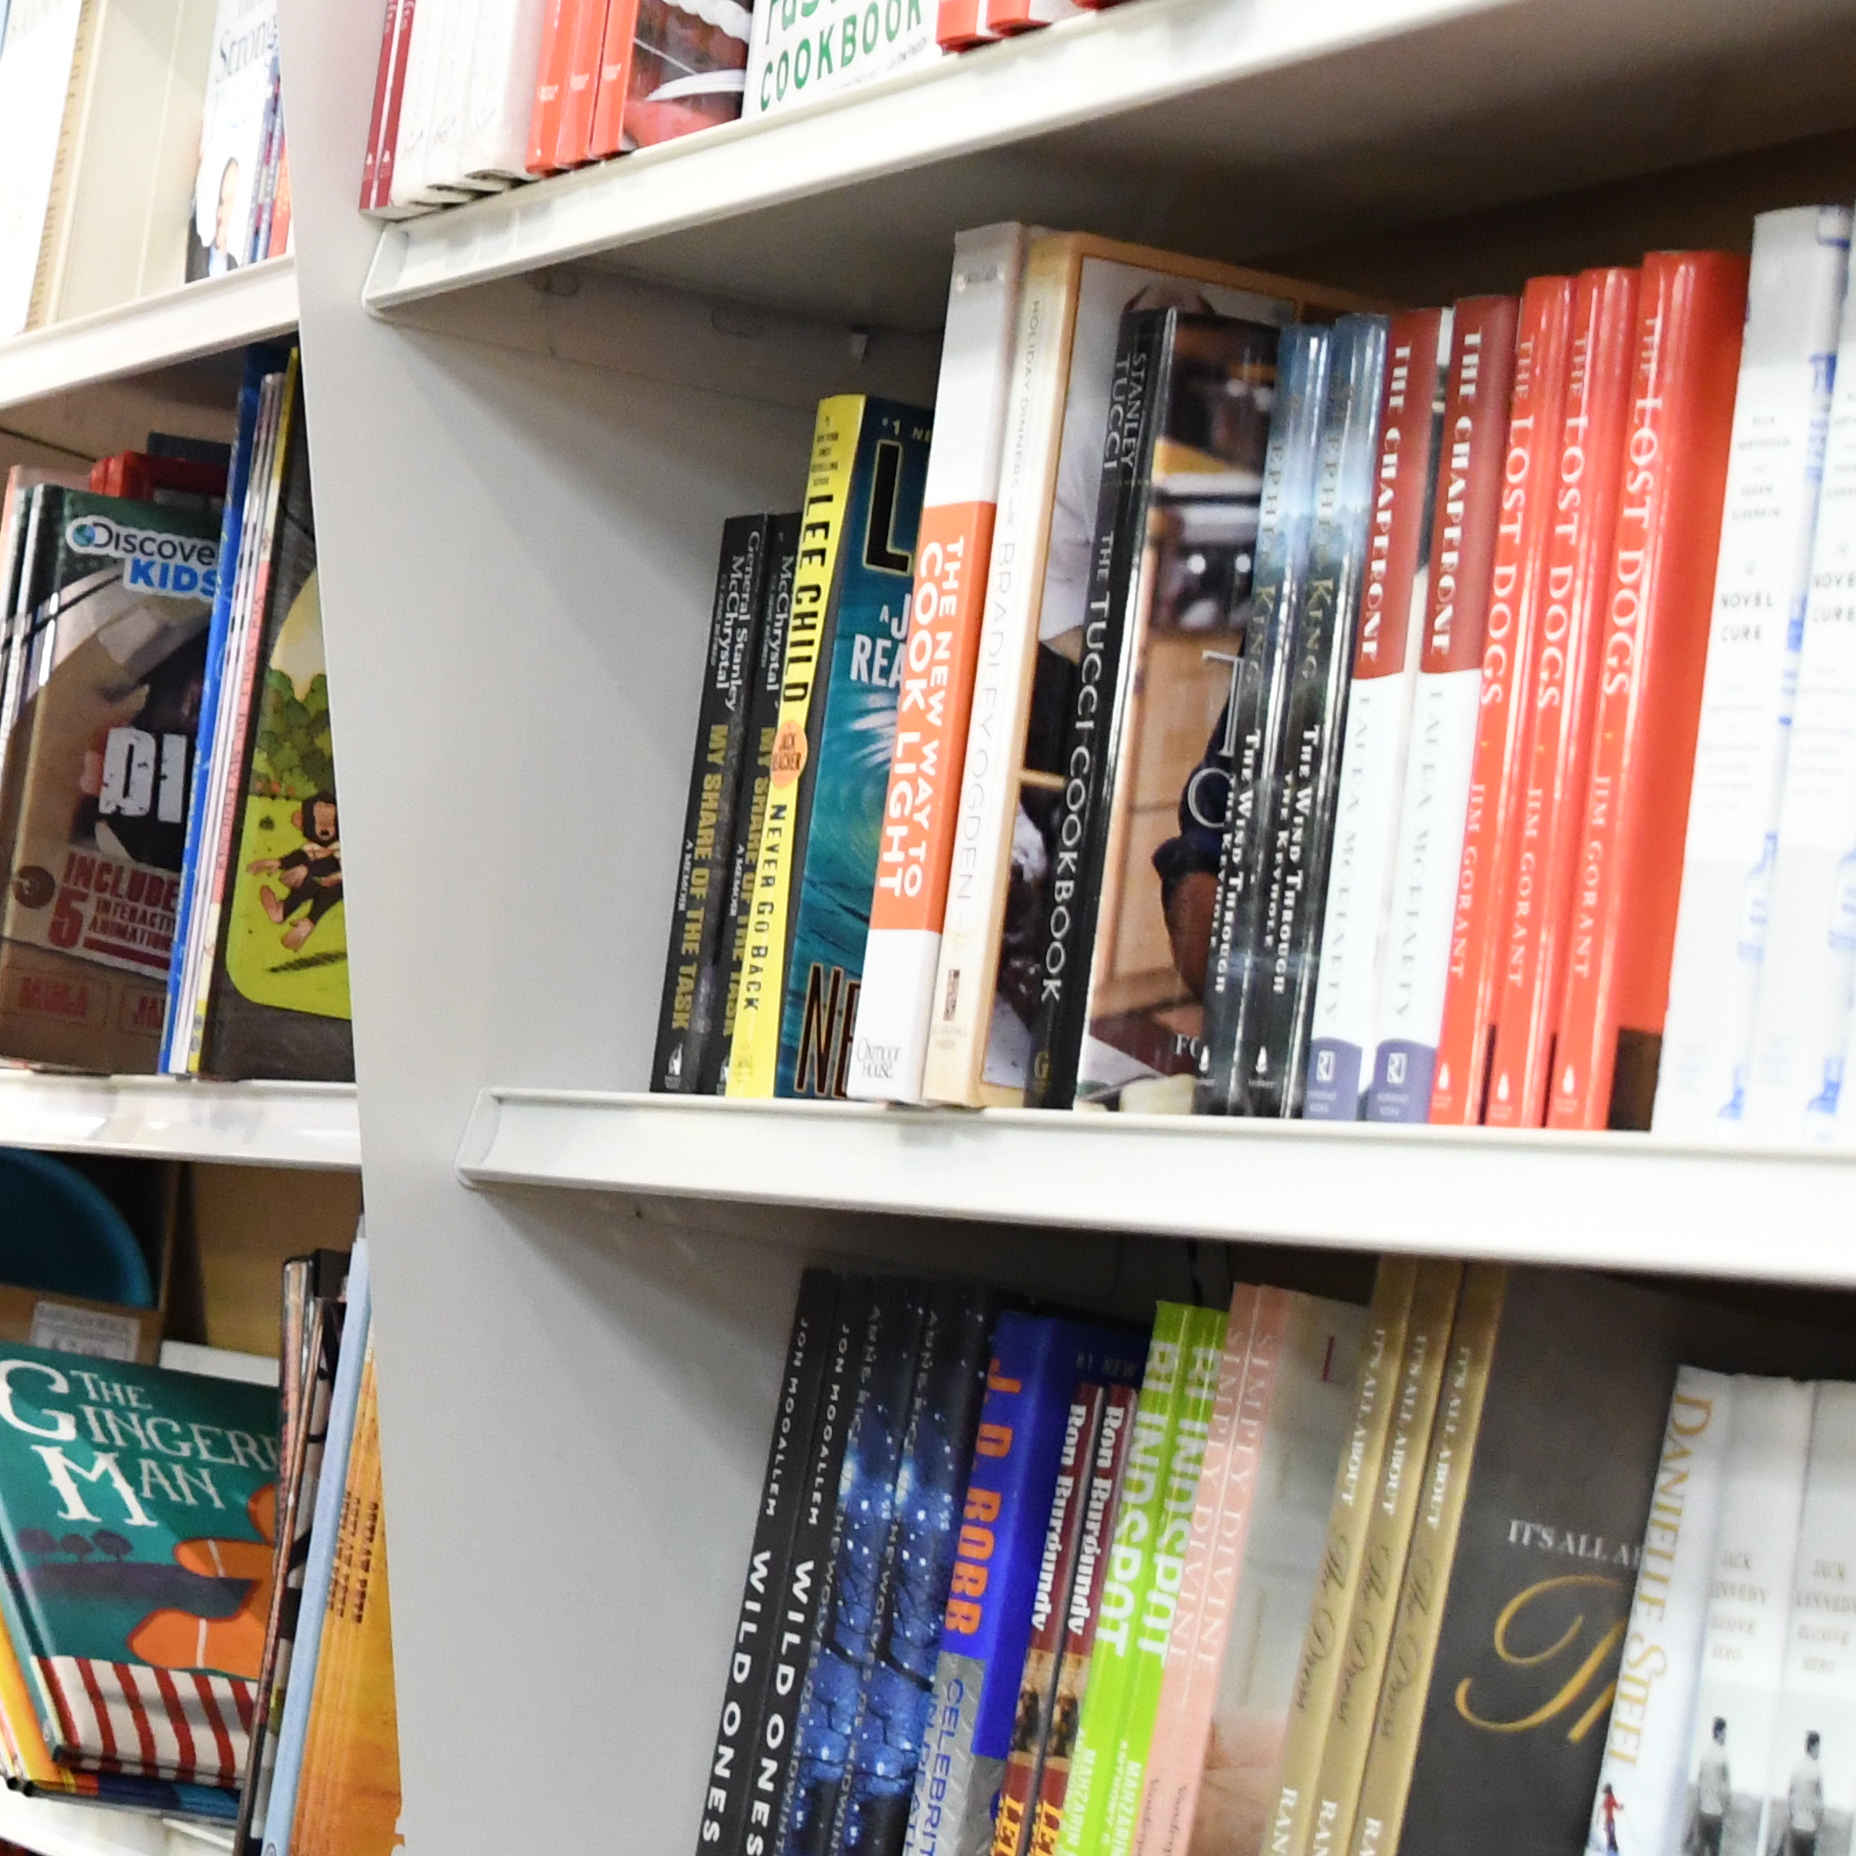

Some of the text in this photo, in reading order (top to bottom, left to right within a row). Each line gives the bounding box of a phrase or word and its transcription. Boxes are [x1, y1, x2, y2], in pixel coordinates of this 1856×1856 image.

[1103, 351, 1146, 471] STANLEY TUCCI
[1430, 329, 1482, 656] THE CHAPERONE
[128, 557, 219, 597] KIDS
[801, 494, 833, 570] LEE
[1360, 344, 1413, 663] THE CHAPERONE
[1479, 413, 1534, 706] LOST DOGS
[1536, 413, 1589, 710] LOST DOGS
[1602, 393, 1663, 697] LOST DOGS
[715, 554, 745, 691] McChrystal
[725, 630, 749, 713] Stanley
[783, 582, 822, 702] CHILD
[1721, 593, 1774, 609] NOVEL
[1721, 626, 1763, 642] CURE
[697, 724, 728, 863] MY SHARE
[878, 542, 943, 898] COOK LIGHT
[902, 536, 964, 898] THE NEW WAY TO
[1041, 531, 1113, 1003] THE TUCCI COOKBOOK
[743, 804, 787, 1011] NEVER GO BACK
[956, 748, 990, 902] OGDEN
[1449, 782, 1487, 979] JIM GORANT
[1508, 786, 1543, 988] JIM GORANT
[1573, 773, 1613, 978] JIM GORANT
[48, 885, 84, 947] 5
[70, 1370, 152, 1410] THE
[764, 1316, 809, 1516] JON MOOALLEM
[808, 1324, 850, 1525] JON MOOALLEM
[1341, 1428, 1366, 1507] ABOUT
[1383, 1433, 1408, 1515] ABOUT
[31, 1445, 226, 1527] MAN
[944, 1488, 1003, 1636] ROBB
[1032, 1403, 1087, 1633] Ron Burgundy
[1068, 1405, 1125, 1635] Ron Burgundy
[1140, 1344, 1225, 1667] BLINDSPOT
[1427, 1445, 1452, 1529] ABOUT
[1507, 1519, 1608, 1562] IT'S ALL
[1170, 1505, 1214, 1664] DIVINE
[1197, 1510, 1241, 1668] DIVINE
[1608, 1394, 1713, 1765] DANIELLE STEEL
[702, 1548, 772, 1844] WILD ONES
[746, 1560, 815, 1856] WILD ONES
